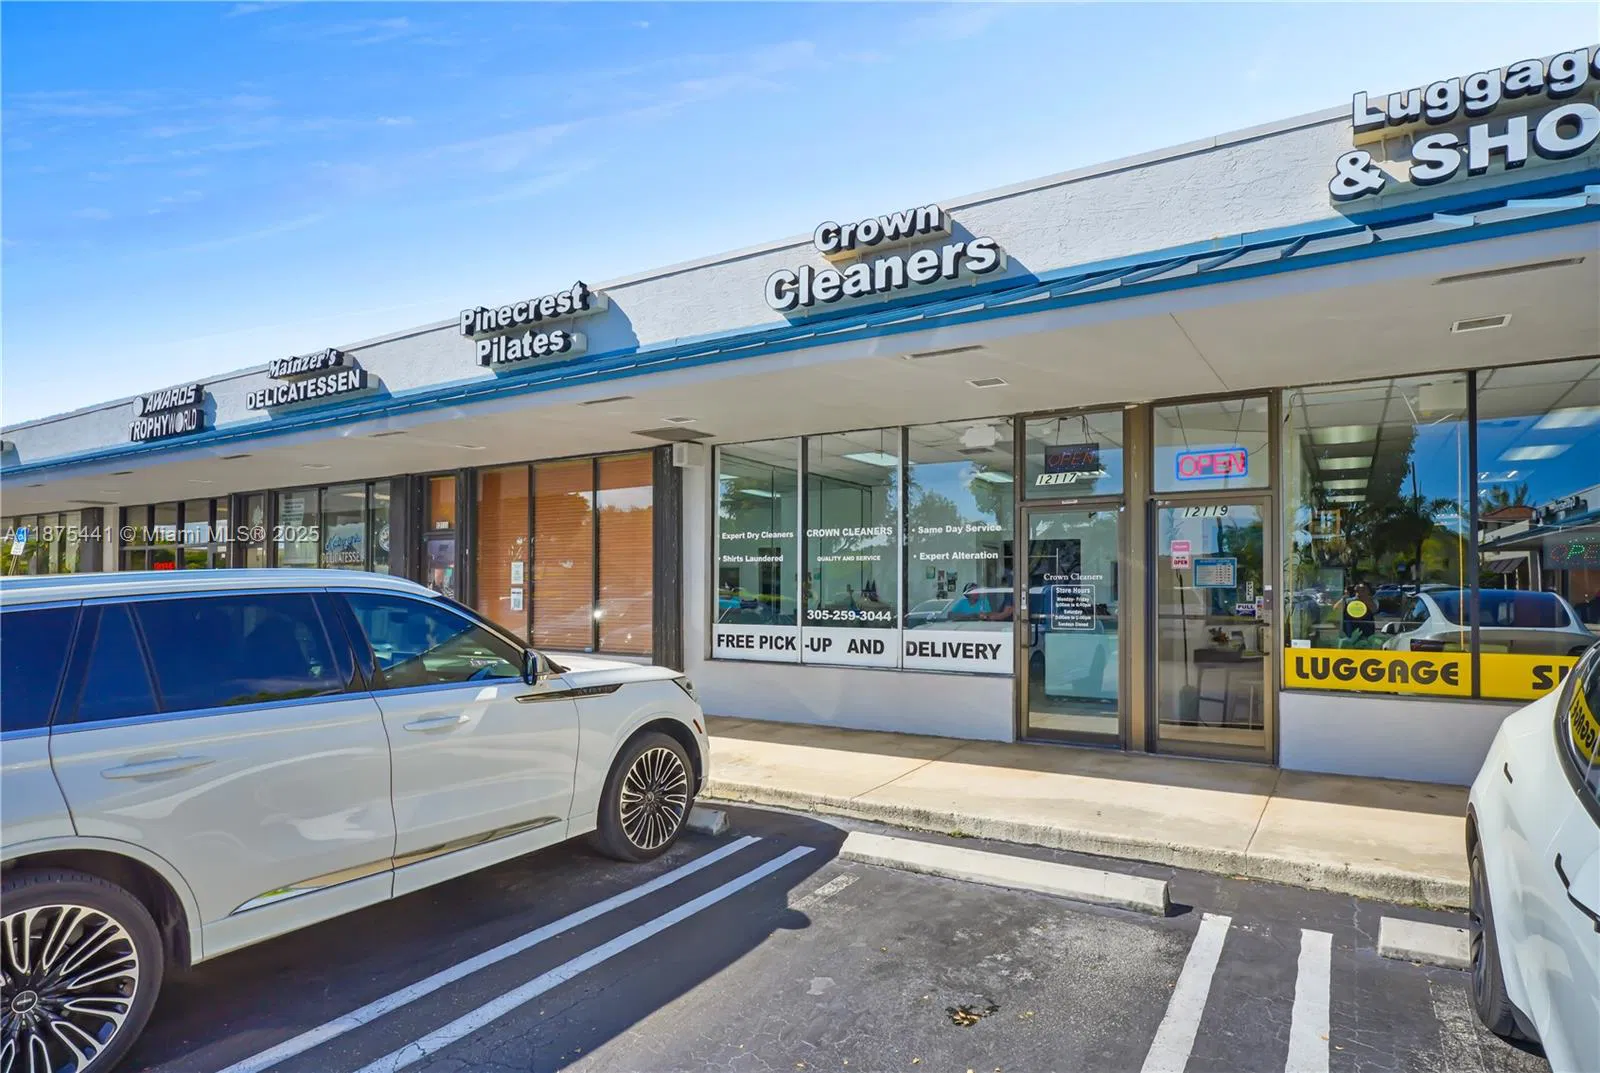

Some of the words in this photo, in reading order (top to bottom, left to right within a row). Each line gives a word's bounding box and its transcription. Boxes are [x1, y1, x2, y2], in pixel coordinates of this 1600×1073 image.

[1353, 47, 1600, 127] Luggag
[1328, 150, 1386, 199] &
[813, 203, 944, 254] Crown
[765, 236, 999, 311] Cleaners
[460, 280, 586, 336] Pinecrest
[475, 329, 567, 366] Pilates
[268, 348, 338, 378] Mainzer's
[145, 384, 198, 414] AWARDS
[246, 369, 361, 410] DELICATESSEN
[1179, 451, 1245, 478] OPEN
[1037, 472, 1078, 486] 12117
[1184, 504, 1229, 518] 12119
[721, 532, 746, 541] Expert
[746, 531, 760, 541] Dry
[761, 531, 794, 539] Cleaners
[806, 528, 840, 537] CROWN
[842, 526, 893, 537] CLEANERS
[918, 526, 943, 534] Same
[945, 525, 963, 535] Day
[965, 523, 1002, 533] Service
[722, 554, 744, 562] Shirts
[745, 554, 784, 562] Laundered
[919, 551, 949, 562] Expert
[951, 551, 999, 560] Alteration
[1043, 573, 1069, 581] Crown
[1070, 573, 1103, 581] Cleaners
[807, 609, 891, 622] 305-259-3044
[717, 634, 755, 650] FREE
[759, 635, 798, 651] PICK
[847, 638, 885, 655] AND
[905, 640, 1002, 661] DELIVERY
[1295, 656, 1460, 687] LUGGAGE
